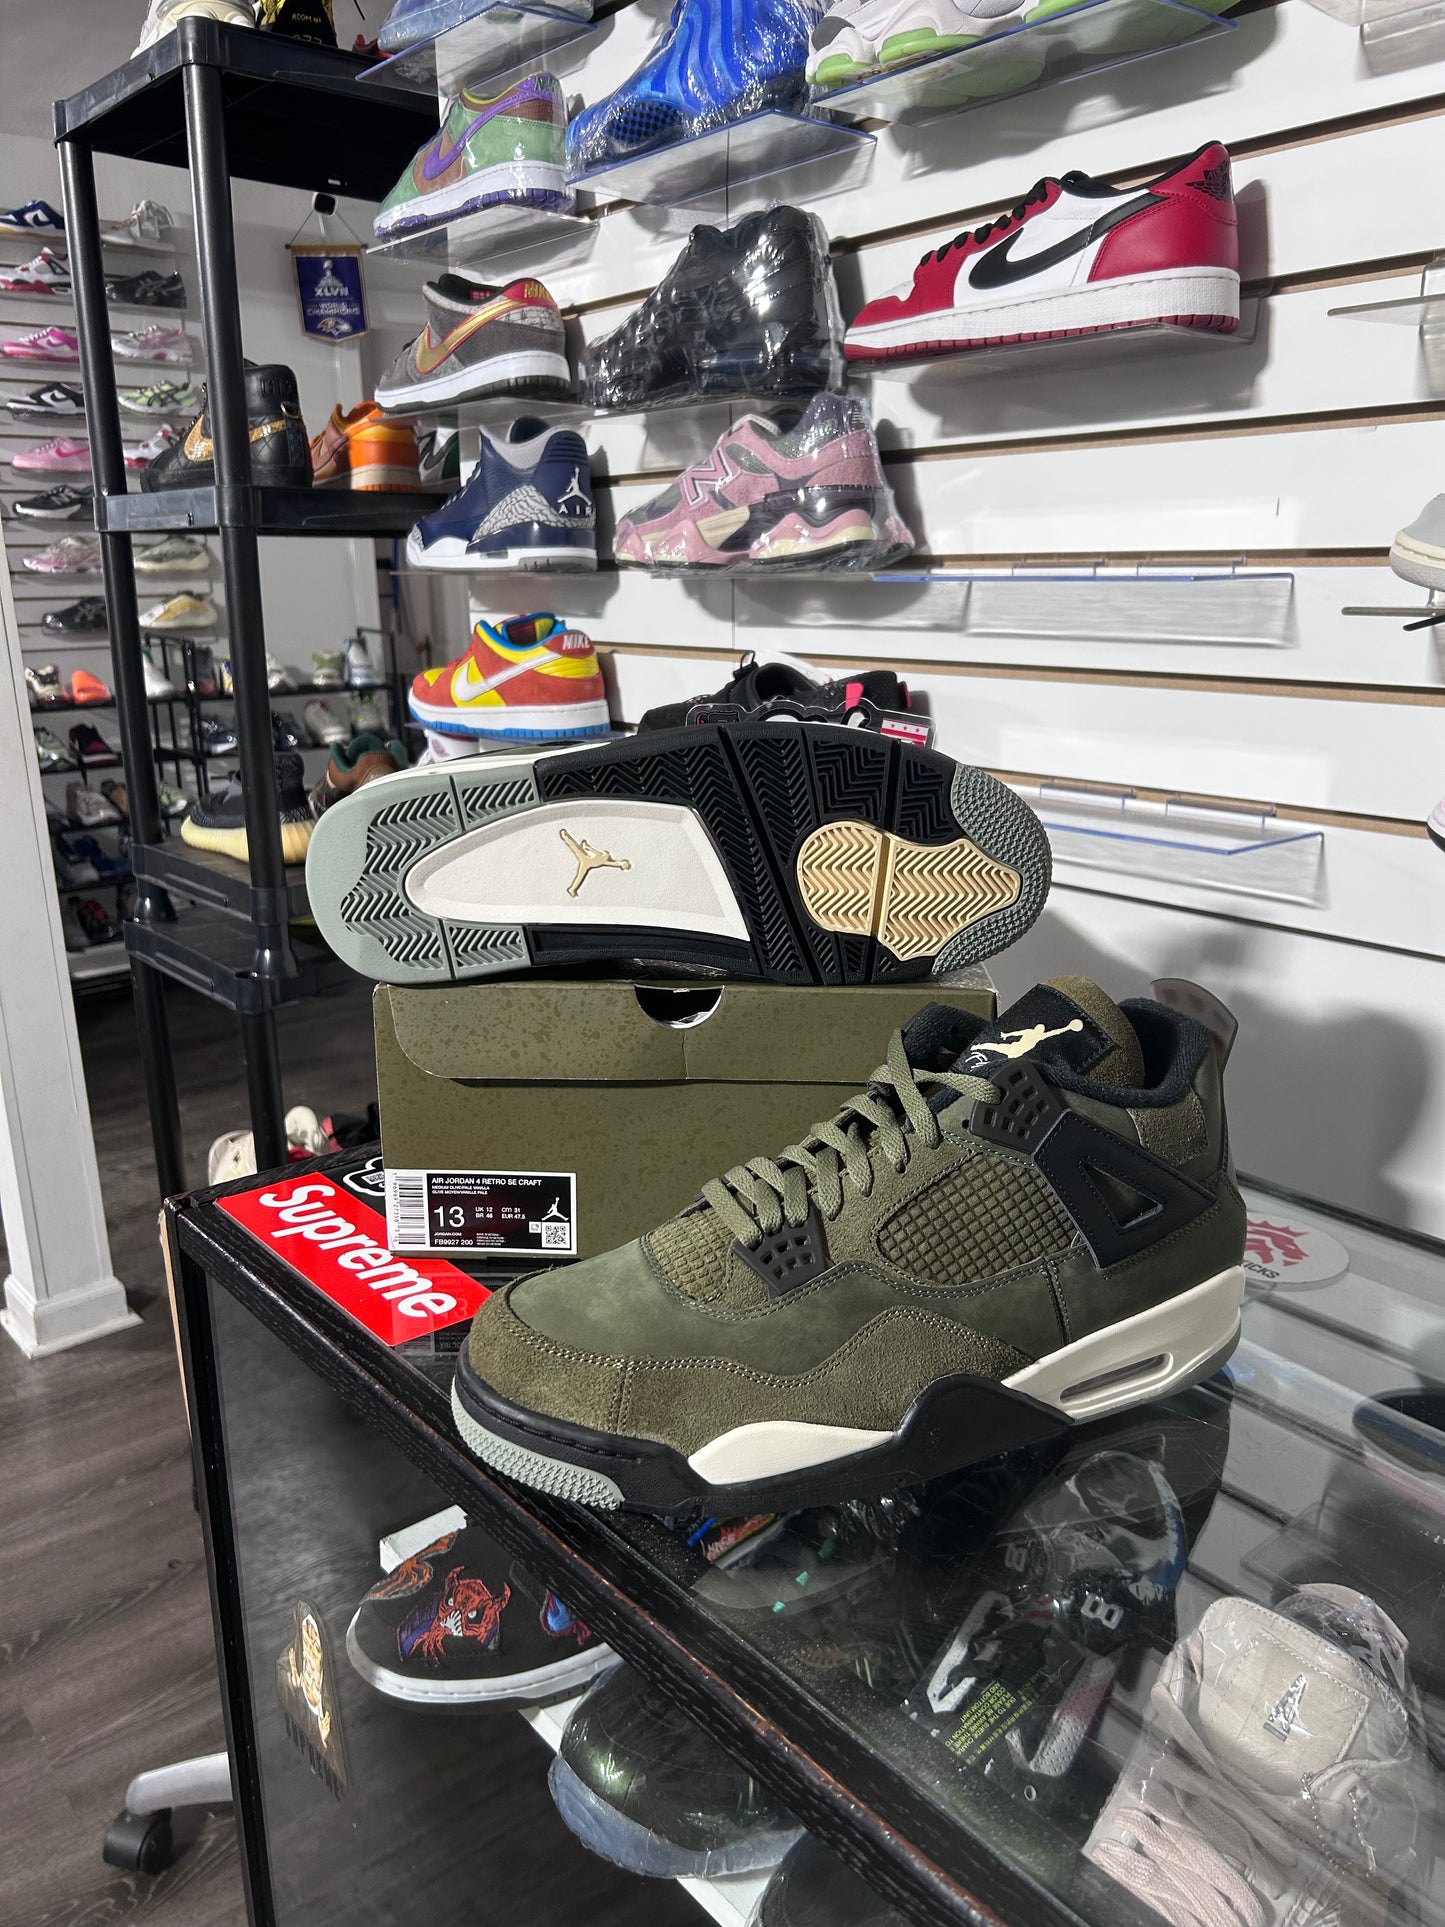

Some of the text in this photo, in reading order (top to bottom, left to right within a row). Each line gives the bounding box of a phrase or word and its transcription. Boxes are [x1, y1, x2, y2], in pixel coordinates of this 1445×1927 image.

[292, 12, 312, 23] ROOM
[558, 503, 592, 516] AIR
[562, 633, 591, 650] NIKE
[445, 1177, 475, 1185] JORDAN
[507, 1178, 517, 1186] SE
[433, 1205, 465, 1228] 13
[258, 1184, 458, 1318] Supreme
[959, 1682, 1001, 1722] AND BOTTOM UNIT
[988, 1687, 1006, 1704] COLOR
[992, 1691, 1011, 1710] PLEASE
[1004, 1696, 1016, 1708] DUE
[985, 1708, 994, 1717] BE
[987, 1713, 999, 1724] THE
[997, 1706, 1006, 1715] TO
[952, 1702, 990, 1739] CONTAMINATION
[968, 1715, 987, 1733] AWARE
[972, 1722, 989, 1739] SUEDE
[944, 1738, 953, 1747] TO
[954, 1731, 970, 1747] THERE
